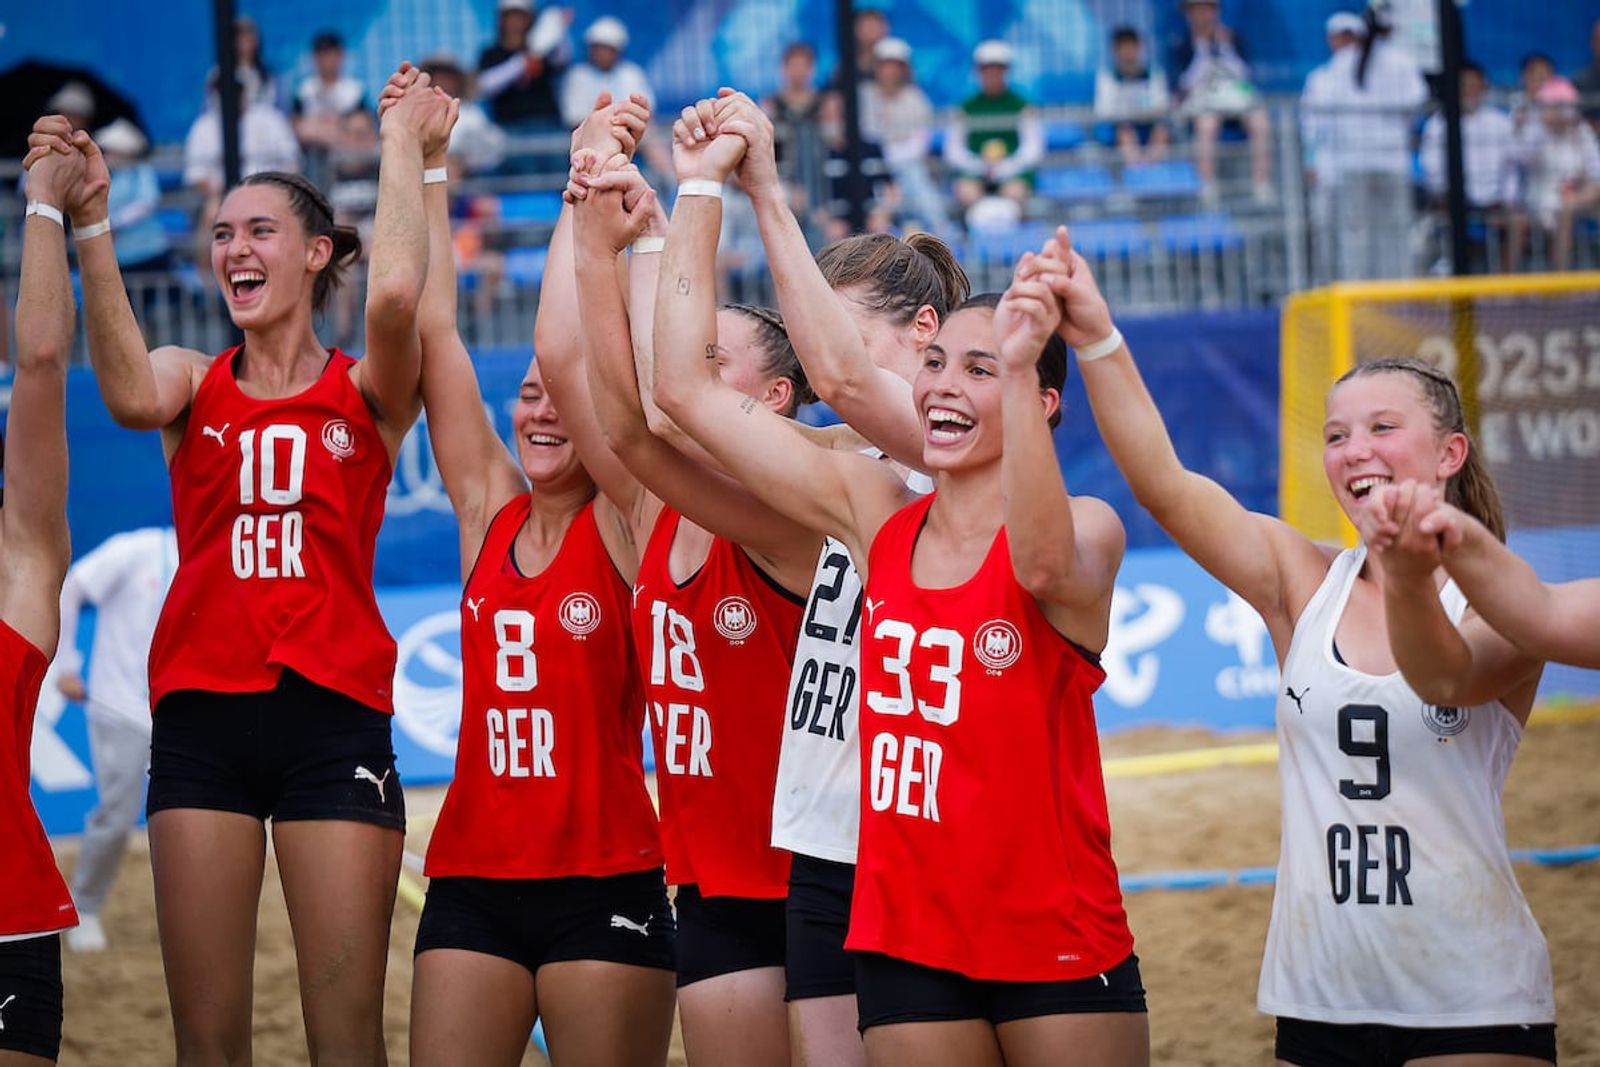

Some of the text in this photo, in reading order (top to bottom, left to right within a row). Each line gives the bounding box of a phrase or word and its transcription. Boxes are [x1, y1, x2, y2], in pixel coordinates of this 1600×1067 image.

[238, 424, 307, 506] 10
[230, 511, 306, 580] GER
[494, 609, 538, 692] 8
[650, 600, 705, 692] 18
[866, 619, 965, 727] 33
[790, 658, 857, 742] GER
[486, 708, 557, 779] GER
[869, 732, 944, 823] GER
[1337, 704, 1391, 800] 9
[1326, 822, 1414, 906] GER
